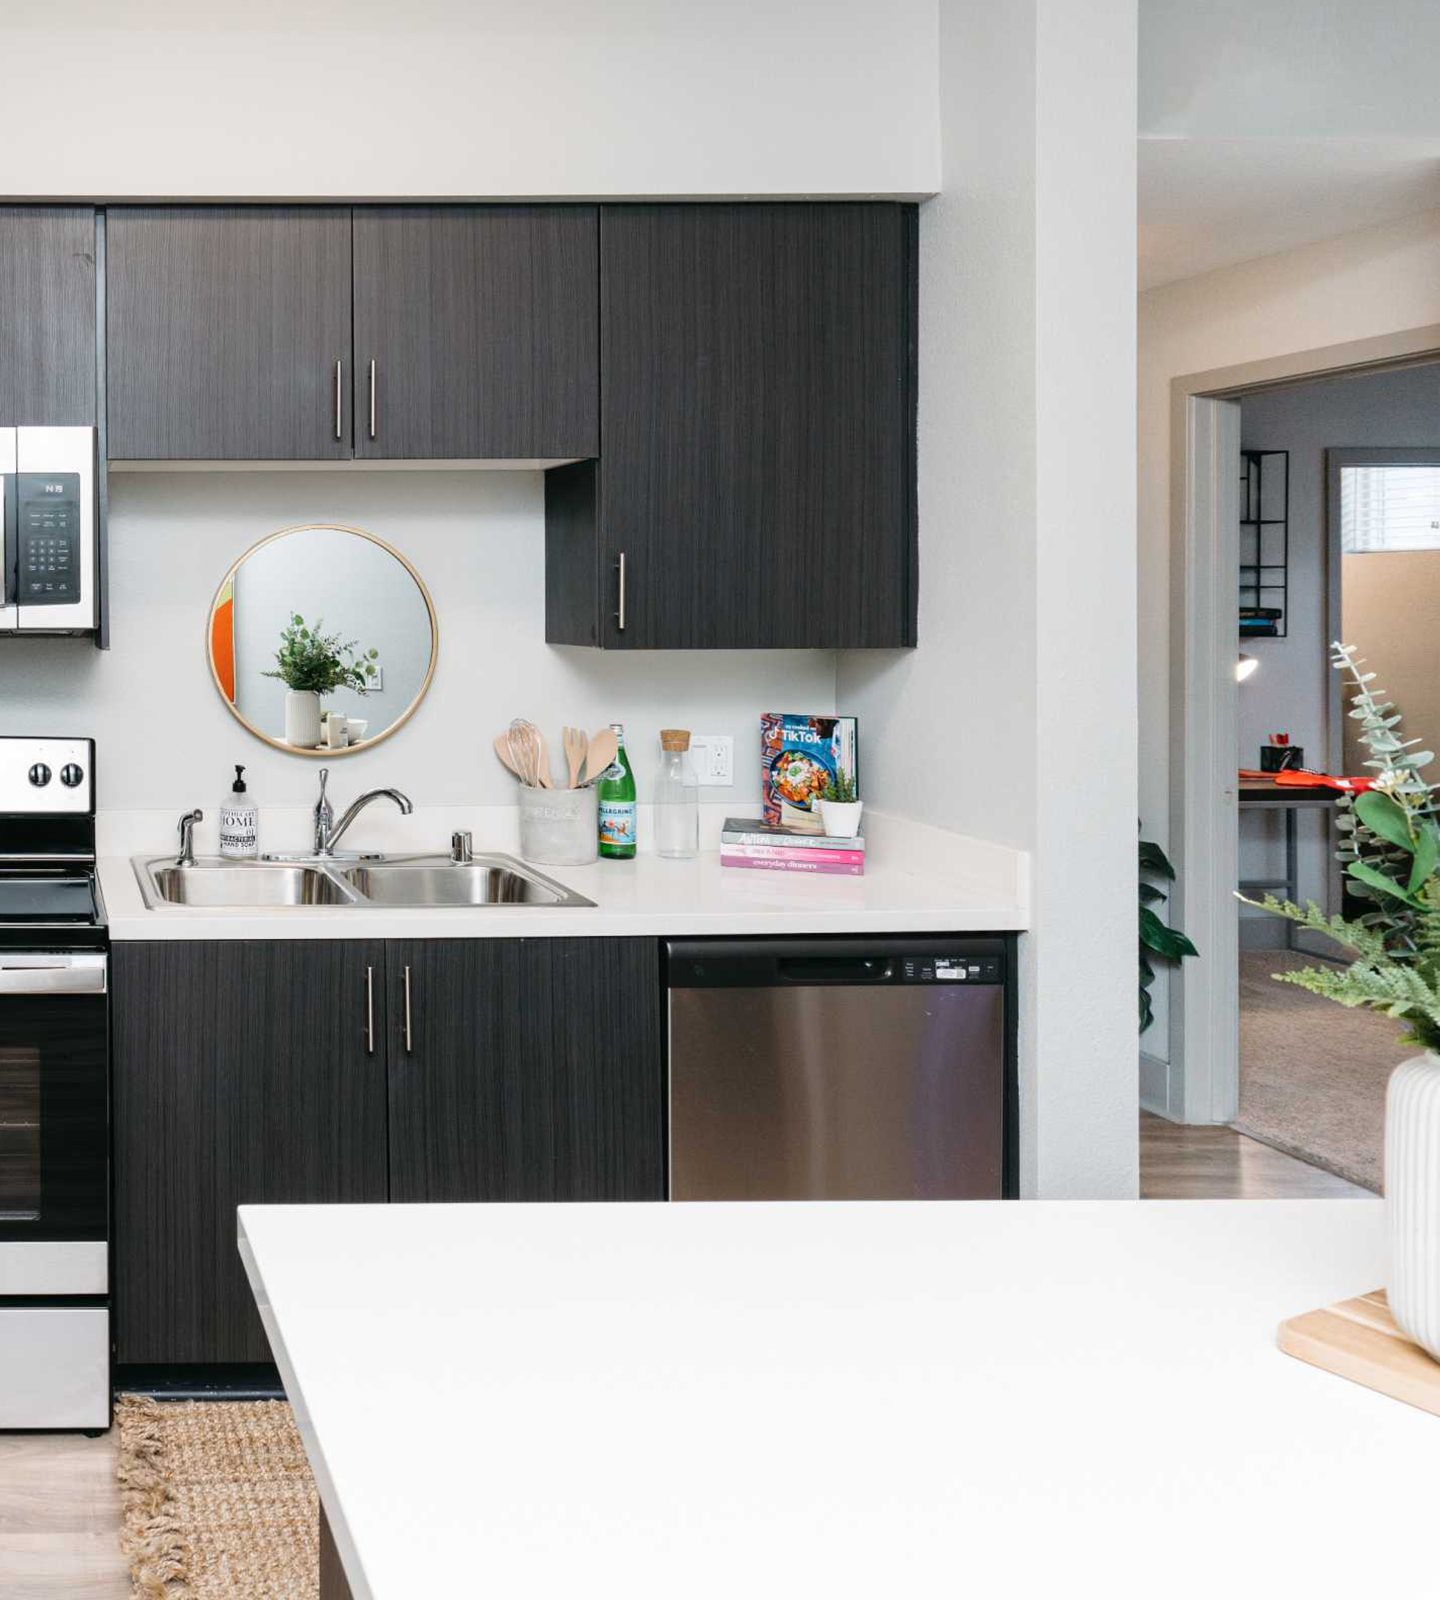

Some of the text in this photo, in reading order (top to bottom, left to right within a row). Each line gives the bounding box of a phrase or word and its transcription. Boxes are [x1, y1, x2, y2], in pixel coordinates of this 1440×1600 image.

[783, 730, 822, 743] TikTok
[753, 859, 817, 870] everyday dinners
